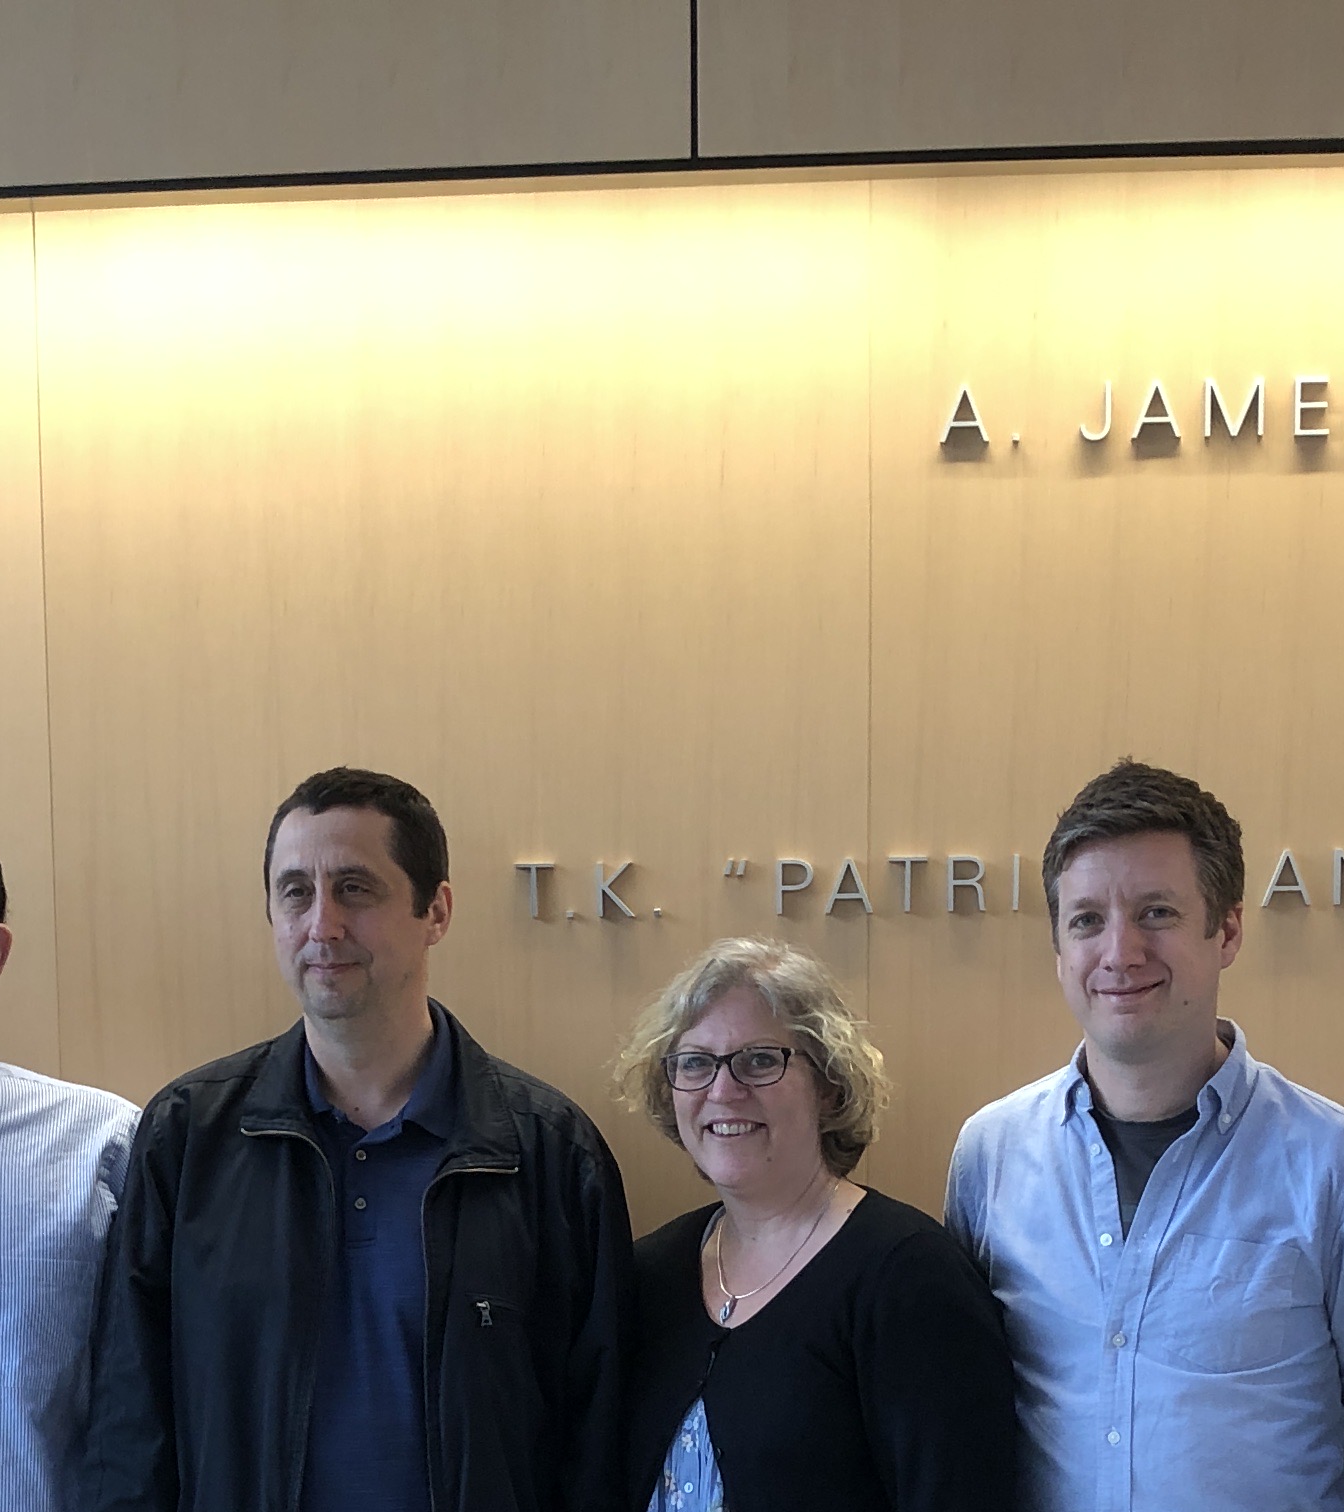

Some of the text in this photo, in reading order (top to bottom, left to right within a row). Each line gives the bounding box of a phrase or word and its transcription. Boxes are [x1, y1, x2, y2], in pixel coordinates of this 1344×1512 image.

[939, 385, 1021, 445] A.
[513, 860, 663, 919] T.K.
[723, 853, 1021, 916] “PATRI
